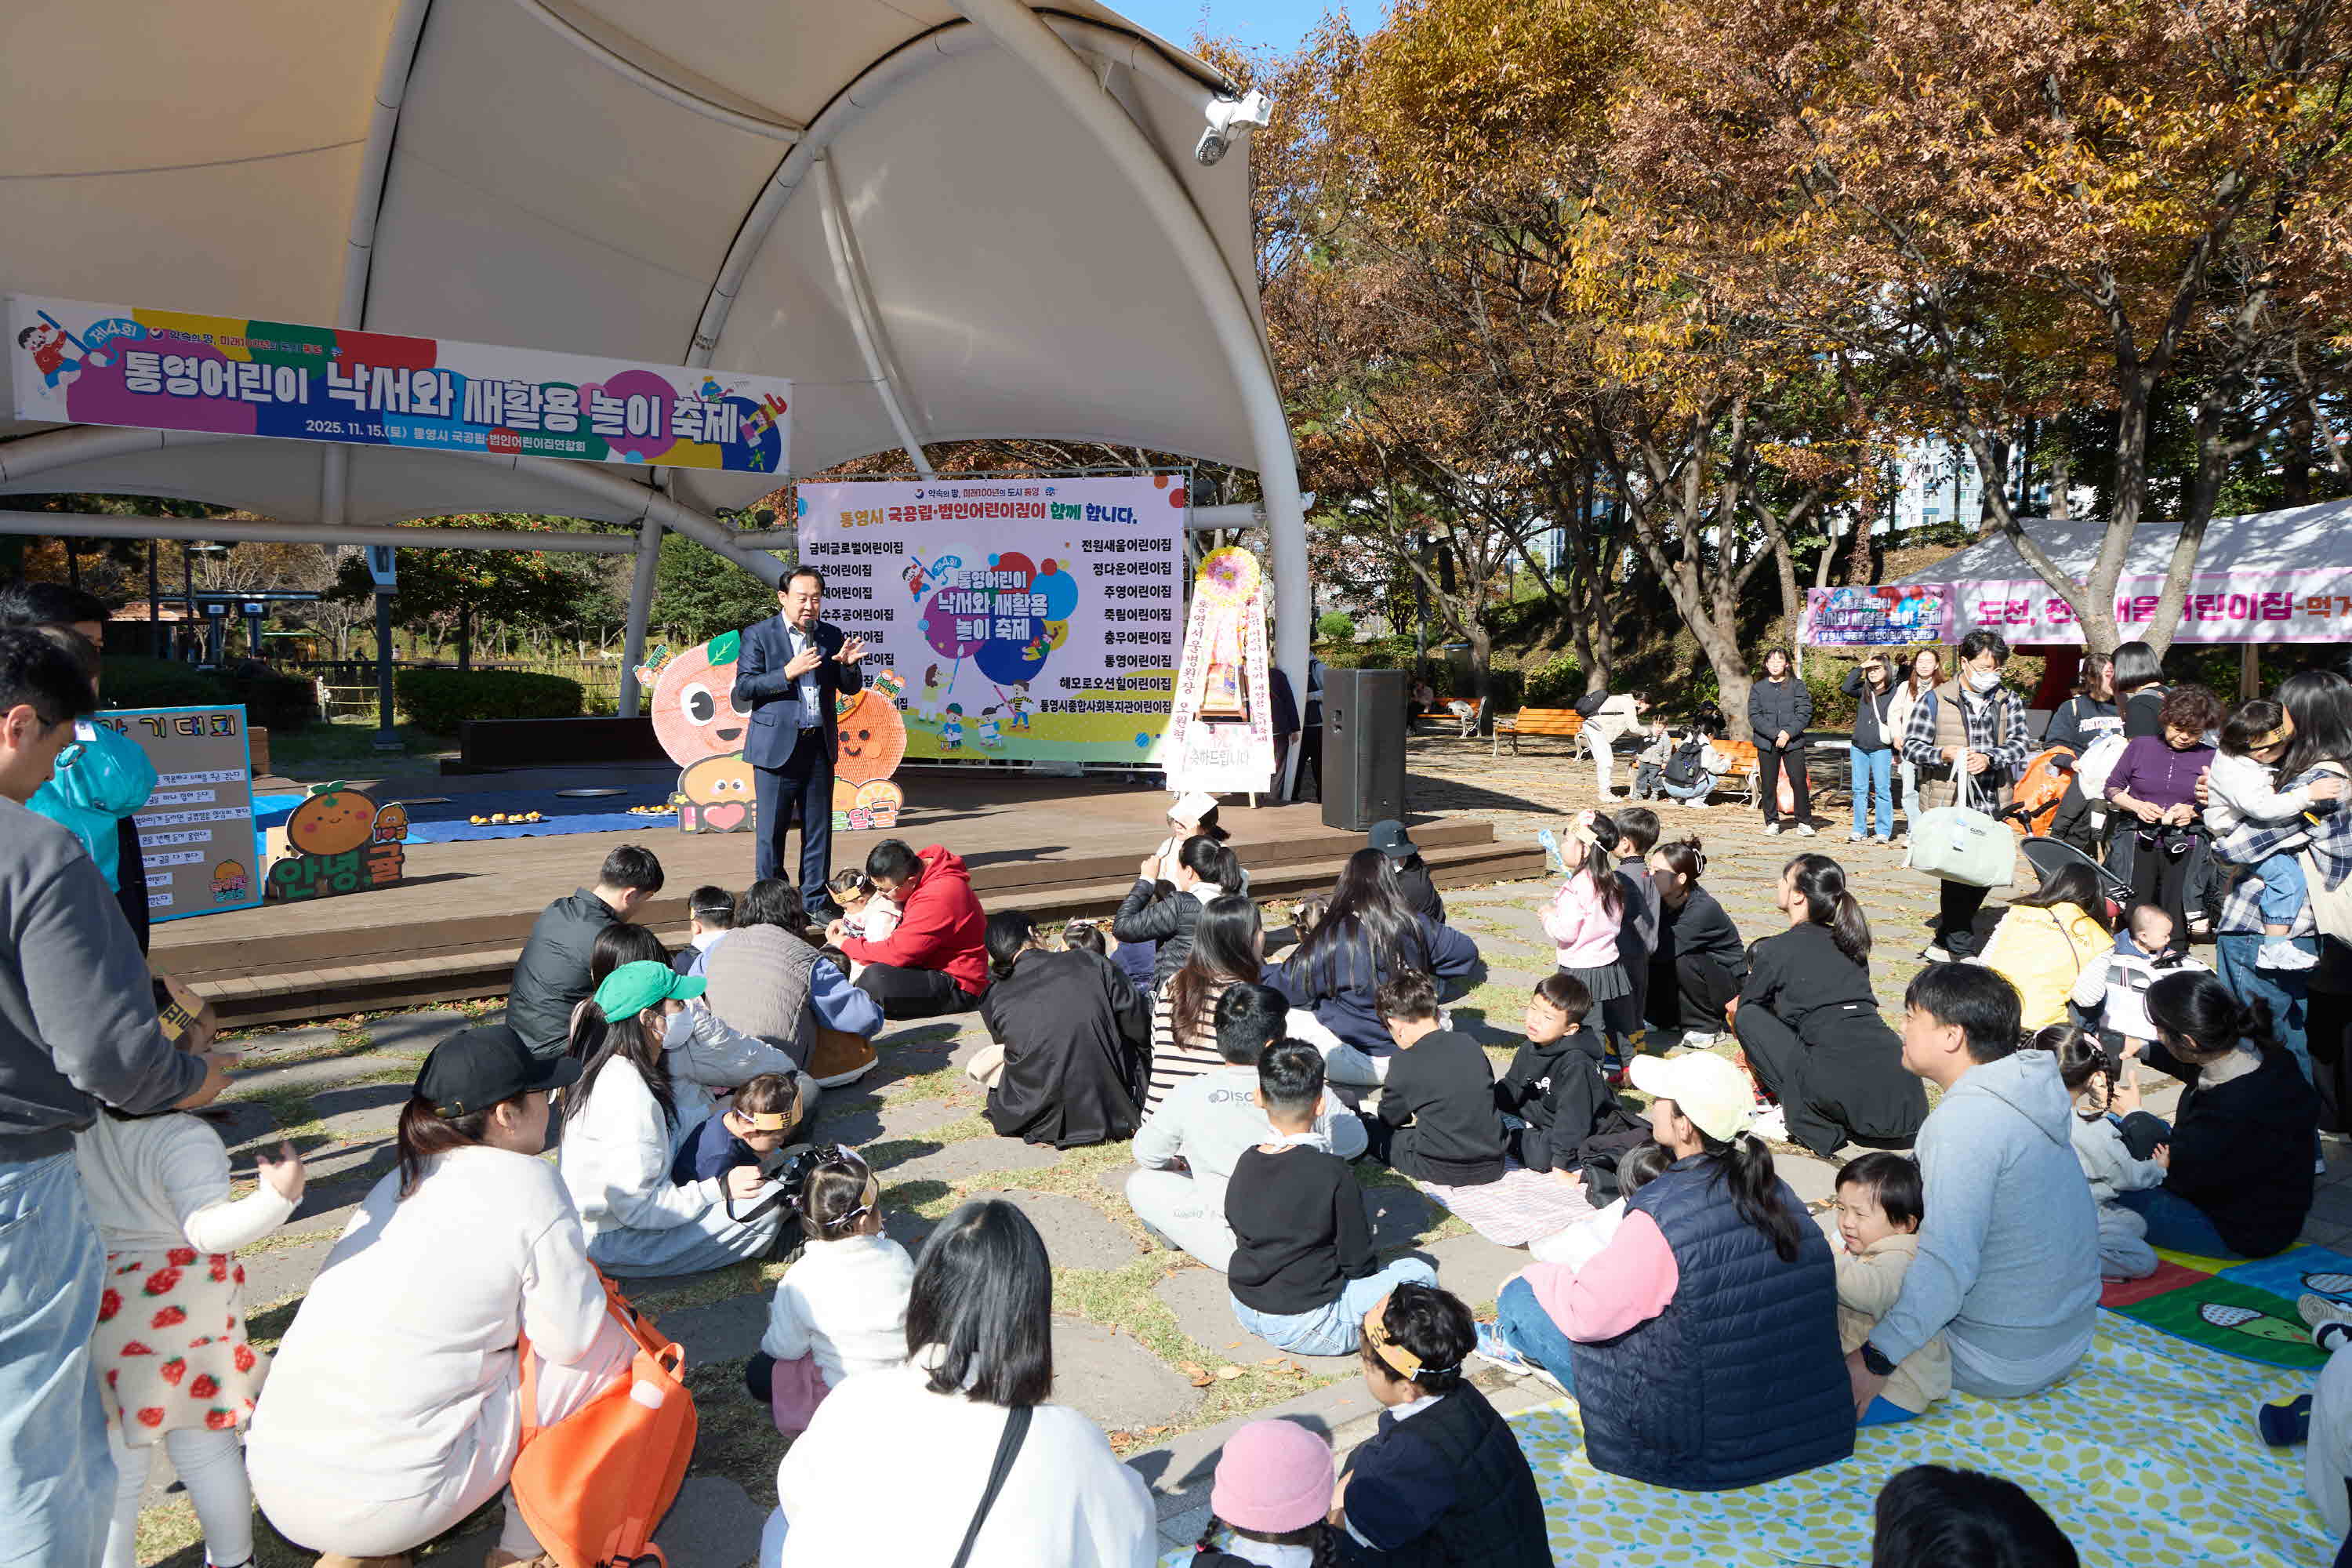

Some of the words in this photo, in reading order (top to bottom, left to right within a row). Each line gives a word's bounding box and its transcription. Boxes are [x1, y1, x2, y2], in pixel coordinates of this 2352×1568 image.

[89, 320, 137, 343] 제4회
[169, 331, 201, 343] 약속의
[125, 350, 309, 404] 통영어린이
[326, 361, 454, 417] 낙서와
[463, 379, 580, 434] 새활용
[590, 390, 661, 437] 놀이
[672, 397, 739, 445] 축제
[306, 419, 344, 434] 2025.
[349, 423, 365, 436] 11.
[414, 427, 448, 441] 통영시
[927, 489, 949, 499] 약속의
[951, 489, 961, 499] 땅,
[964, 488, 1005, 499] 미래100년의
[1007, 488, 1022, 498] 도시
[1024, 487, 1040, 497] 통영
[840, 507, 884, 528] 통영시
[887, 502, 1046, 524] 국공립·법인어린이집이
[1051, 502, 1082, 521] 함께
[1087, 503, 1138, 524] 합니다.
[809, 541, 903, 556] 금비글로벌어린이집
[1081, 538, 1171, 553] 전원새움어린이집
[810, 564, 872, 577] 천어린이집
[1093, 561, 1171, 576] 정다운어린이집
[958, 571, 1027, 590] 통영어린이
[1104, 586, 1171, 599] 주영어린이집
[938, 592, 991, 615] 낙서와
[994, 593, 1047, 616] 새활용
[1843, 597, 1891, 609] 통영어린이
[1104, 608, 1171, 622] 죽림어린이집
[1816, 612, 1849, 626] 낙서와
[1889, 610, 1914, 626] 놀이
[1918, 610, 1942, 625] 축제
[1977, 599, 2037, 626] 도천,
[956, 618, 989, 641] 놀이
[995, 618, 1029, 641] 축제
[1104, 631, 1171, 644] 충무어린이집
[1104, 654, 1171, 668] 통영어린이집
[1059, 677, 1171, 691] 해모로오션힐어린이집
[1040, 699, 1171, 714] 통영시종합사회복지관어린이집
[276, 851, 358, 898] 안녕
